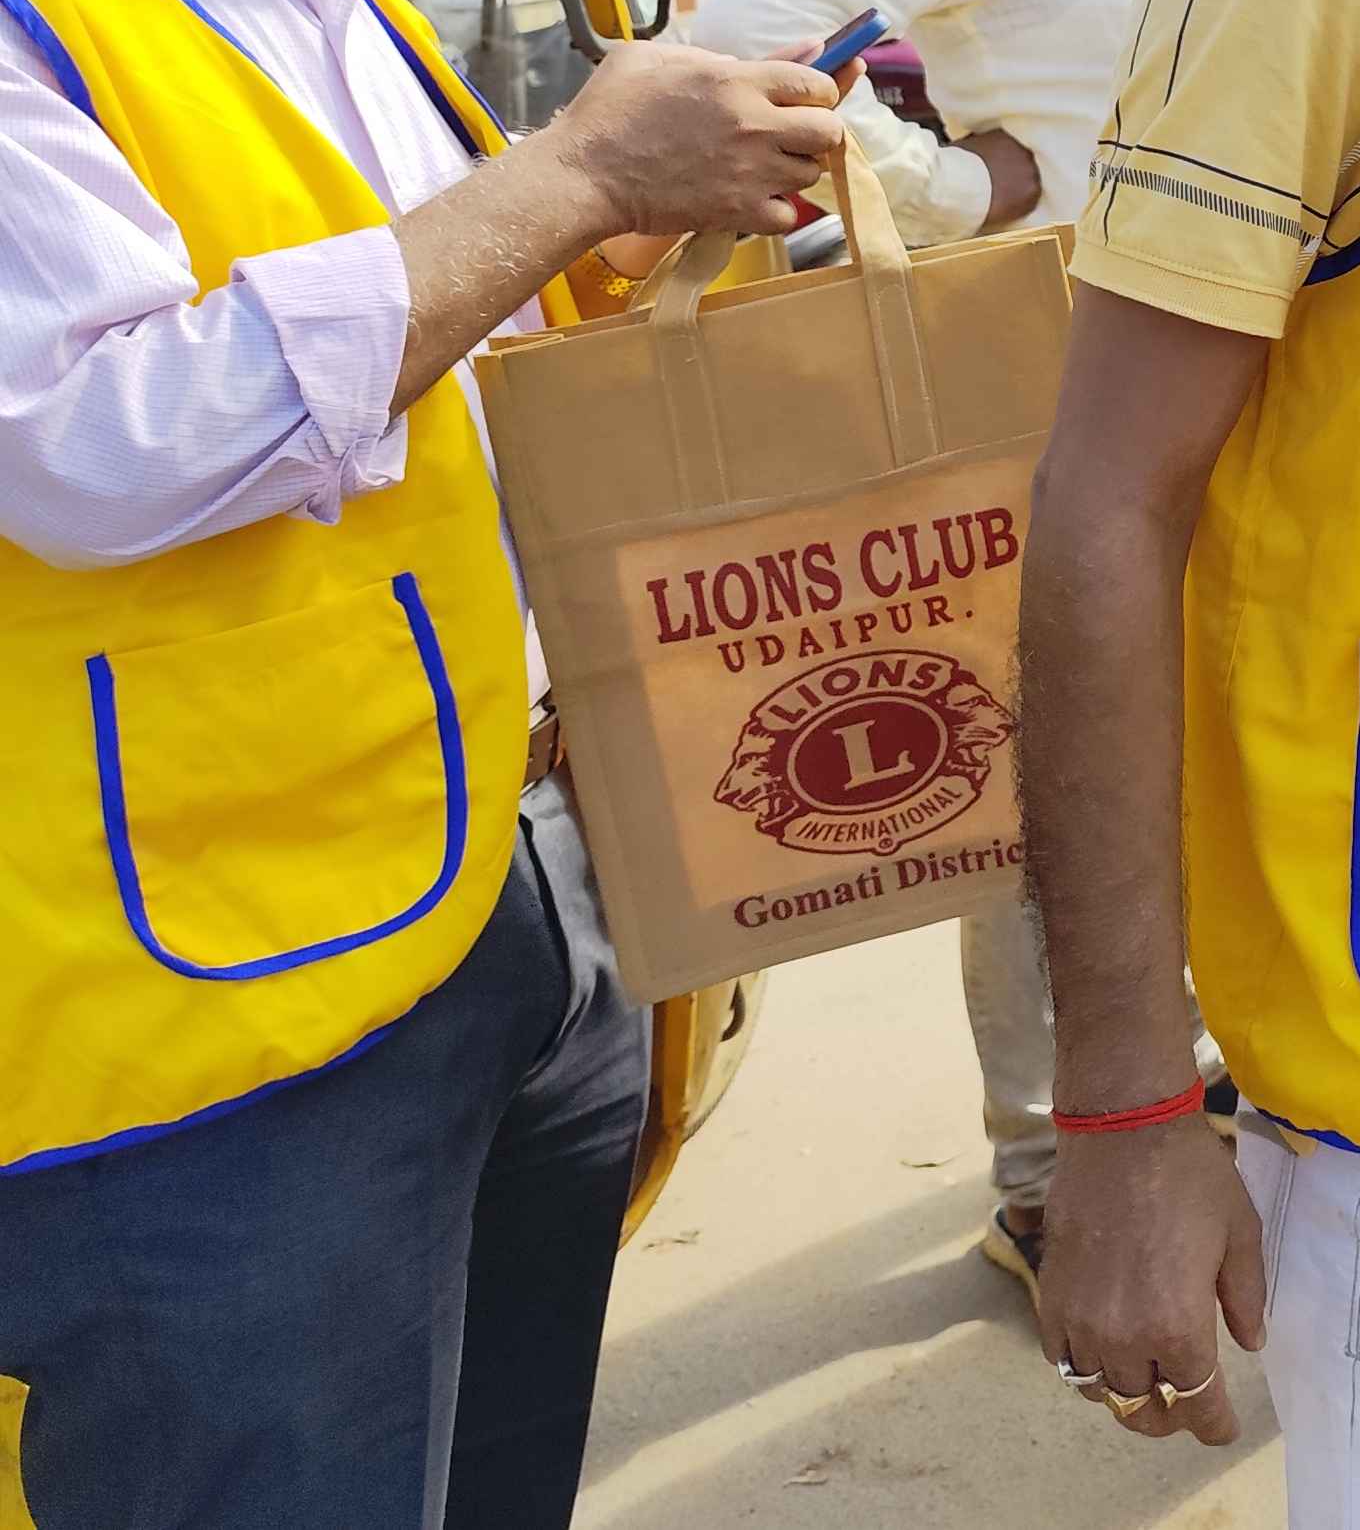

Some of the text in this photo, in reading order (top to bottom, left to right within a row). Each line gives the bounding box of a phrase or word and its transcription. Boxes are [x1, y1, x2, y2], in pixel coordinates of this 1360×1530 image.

[645, 506, 1021, 645] LIONS CLUB
[717, 594, 976, 674] UDAIPUR.
[768, 658, 944, 726] LIONS
[832, 718, 917, 792] L
[794, 784, 964, 844] INTERNATIONAL
[733, 838, 1028, 930] Gomati Distric
